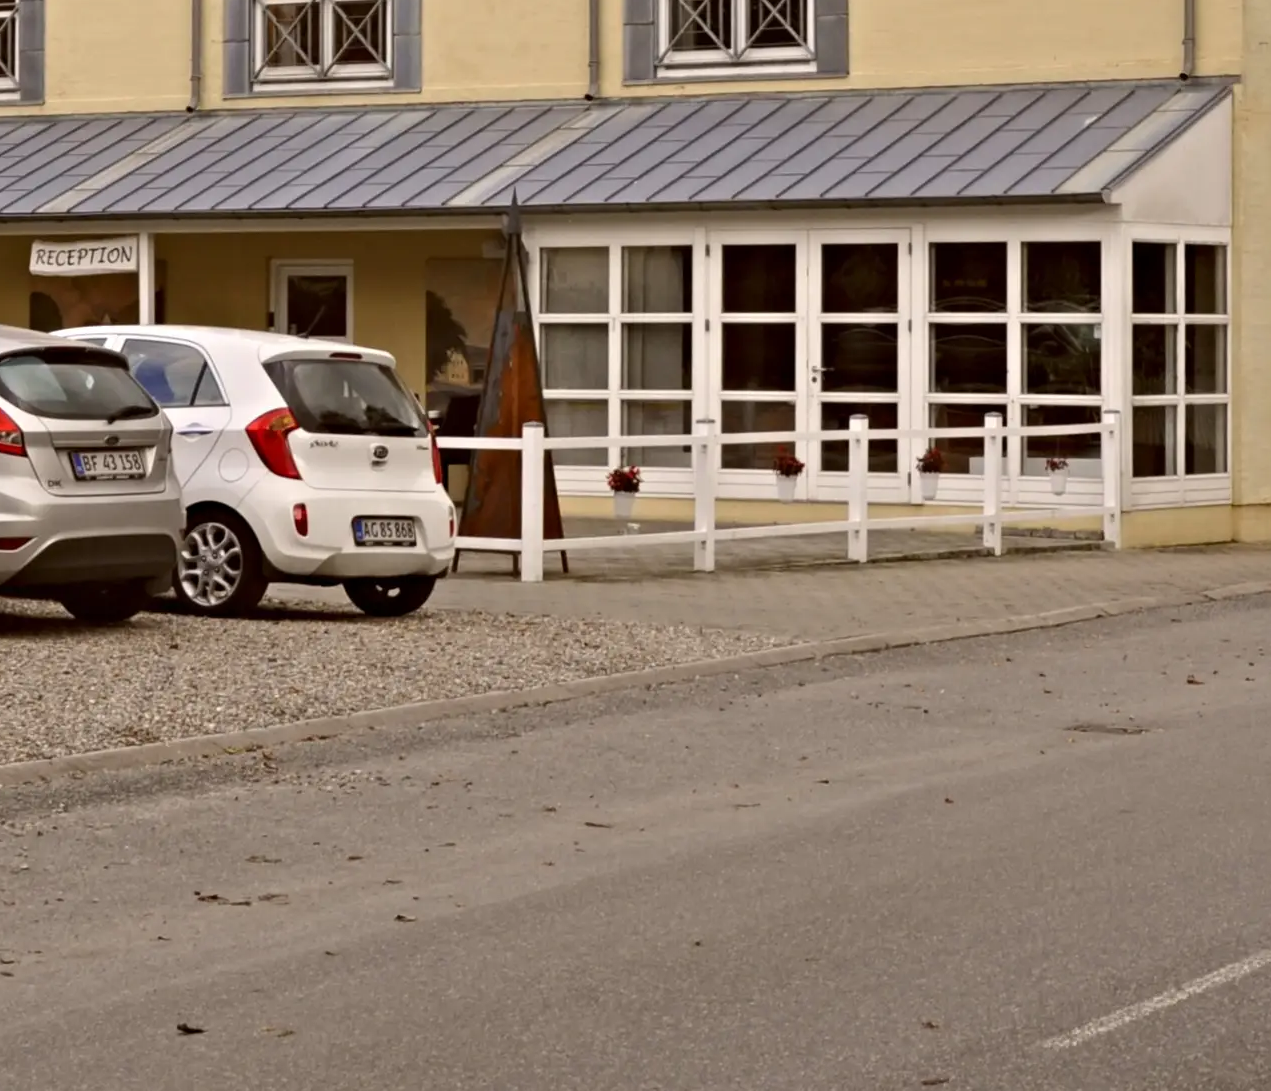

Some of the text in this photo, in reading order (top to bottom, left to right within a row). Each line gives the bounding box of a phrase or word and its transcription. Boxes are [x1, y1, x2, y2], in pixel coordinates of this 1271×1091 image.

[35, 245, 133, 267] RECEPTION
[81, 453, 142, 472] BF 43 158
[364, 521, 379, 538] AG
[379, 521, 393, 538] 85
